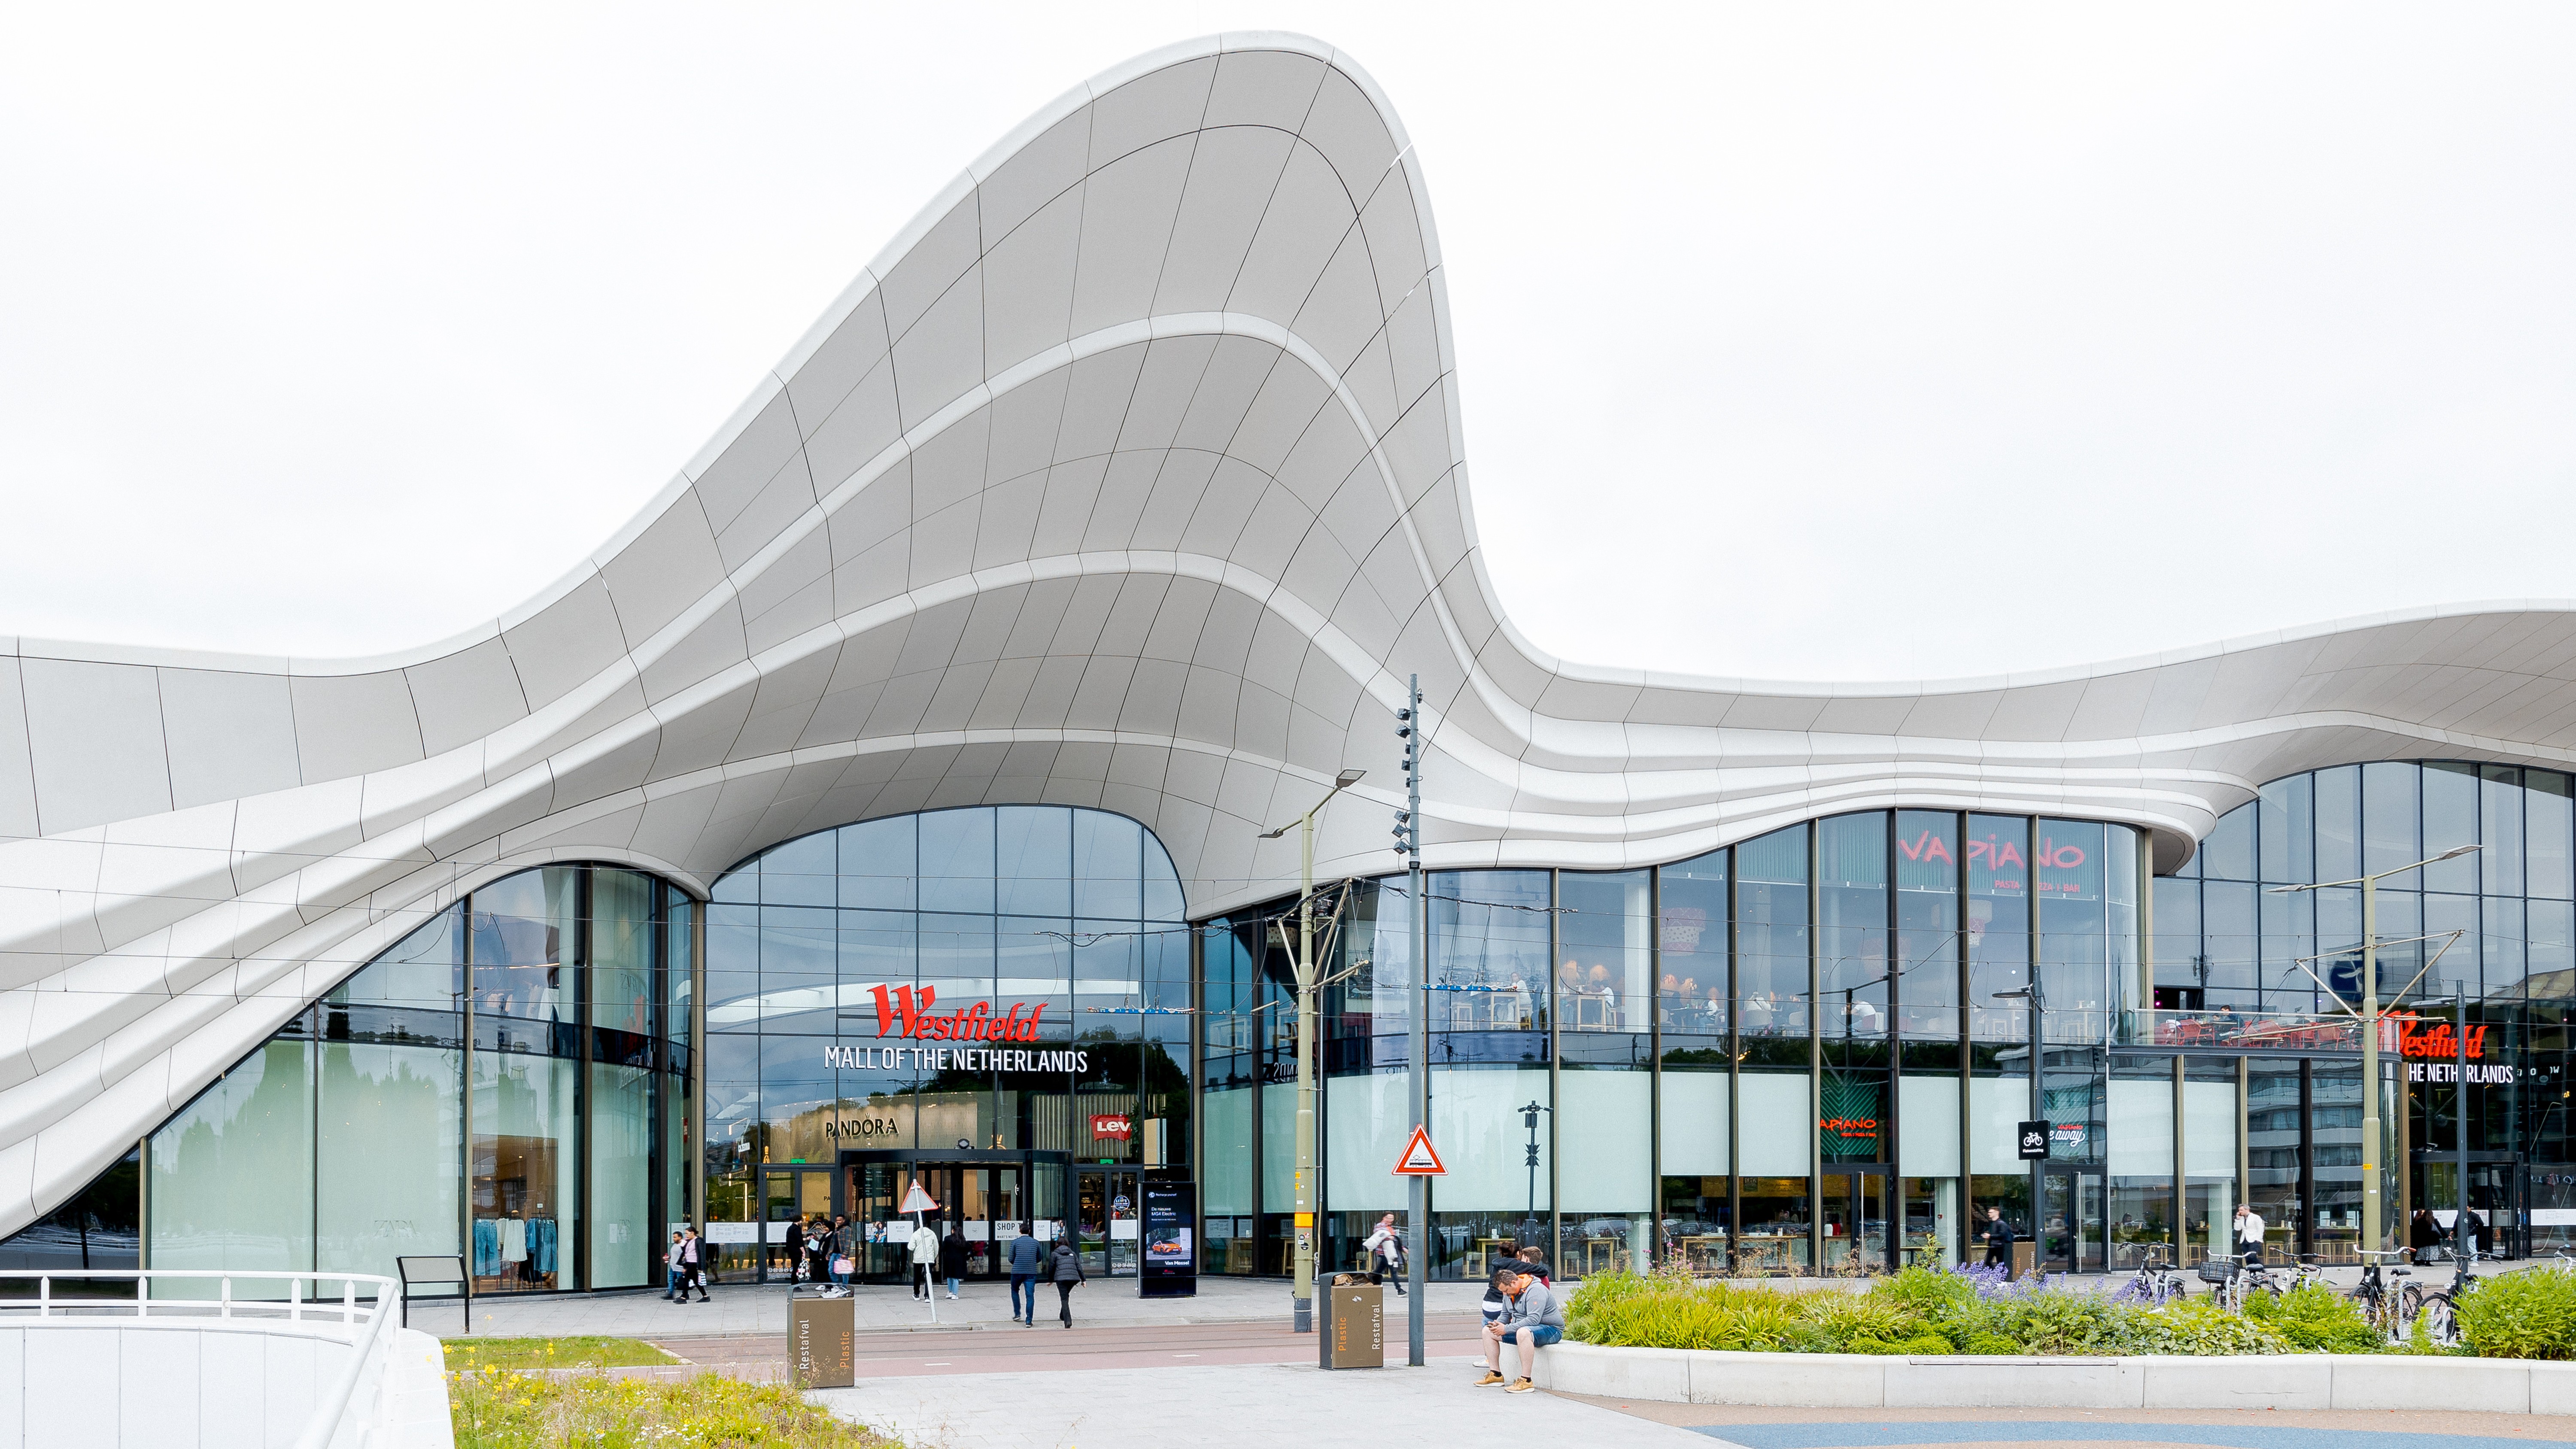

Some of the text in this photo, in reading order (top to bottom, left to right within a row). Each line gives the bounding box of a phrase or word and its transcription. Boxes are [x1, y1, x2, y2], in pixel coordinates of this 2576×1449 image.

[1994, 880, 2020, 889] PASTA
[2063, 884, 2080, 893] BAR
[866, 983, 1049, 1042] Westfield
[824, 1046, 1088, 1072] MALL OF THE NETHERLANDS
[2427, 1063, 2514, 1083] NETHRLANDS
[826, 1117, 899, 1138] PANDORA
[2055, 1130, 2086, 1147] away
[374, 1220, 417, 1237] ZARA
[1338, 1317, 1346, 1351] Plastic
[1371, 1304, 1380, 1350] Restafval
[799, 1319, 809, 1370] Restafval
[839, 1331, 850, 1368] Plastic
